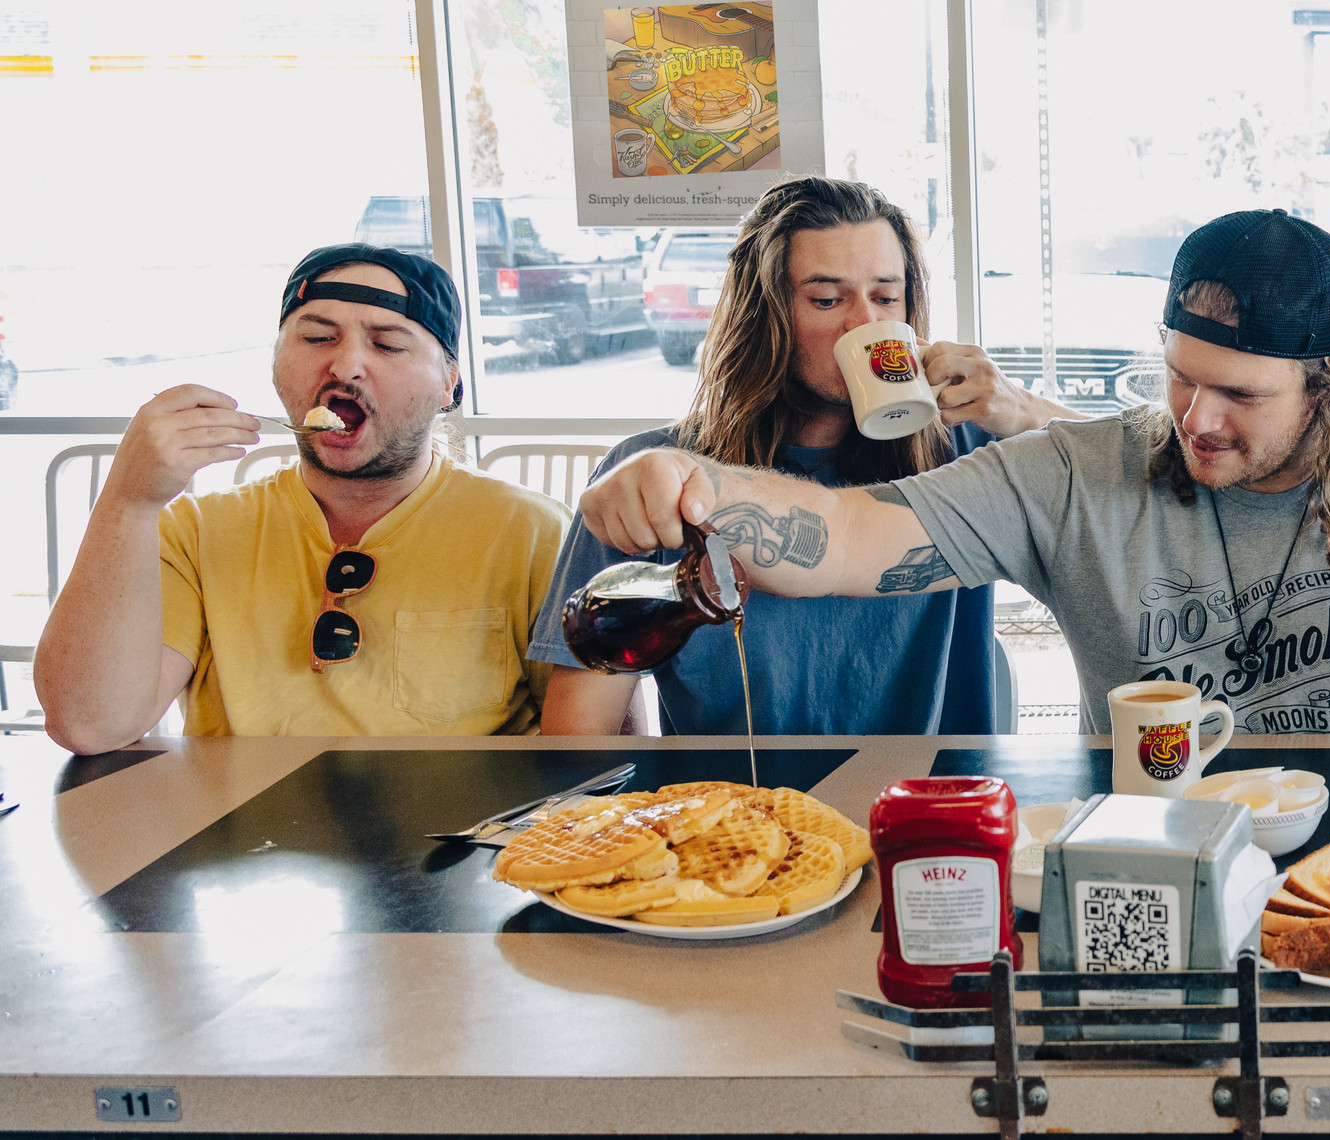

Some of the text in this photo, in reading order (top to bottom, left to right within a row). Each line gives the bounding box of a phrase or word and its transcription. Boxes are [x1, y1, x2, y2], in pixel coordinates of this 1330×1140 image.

[665, 45, 744, 82] BUTTER
[588, 193, 630, 207] Simply
[634, 194, 689, 206] delicious,
[871, 348, 912, 359] HOUS
[1225, 594, 1250, 616] YEAR
[1251, 580, 1274, 601] OLD
[1138, 599, 1207, 656] 100
[1138, 720, 1191, 734] WAFFLE
[1144, 731, 1189, 744] HOUSE
[1148, 763, 1185, 778] COFFEE
[922, 867, 967, 882] HEINZ
[1089, 886, 1163, 902] DIGITAL MENU
[121, 1092, 150, 1116] 11
